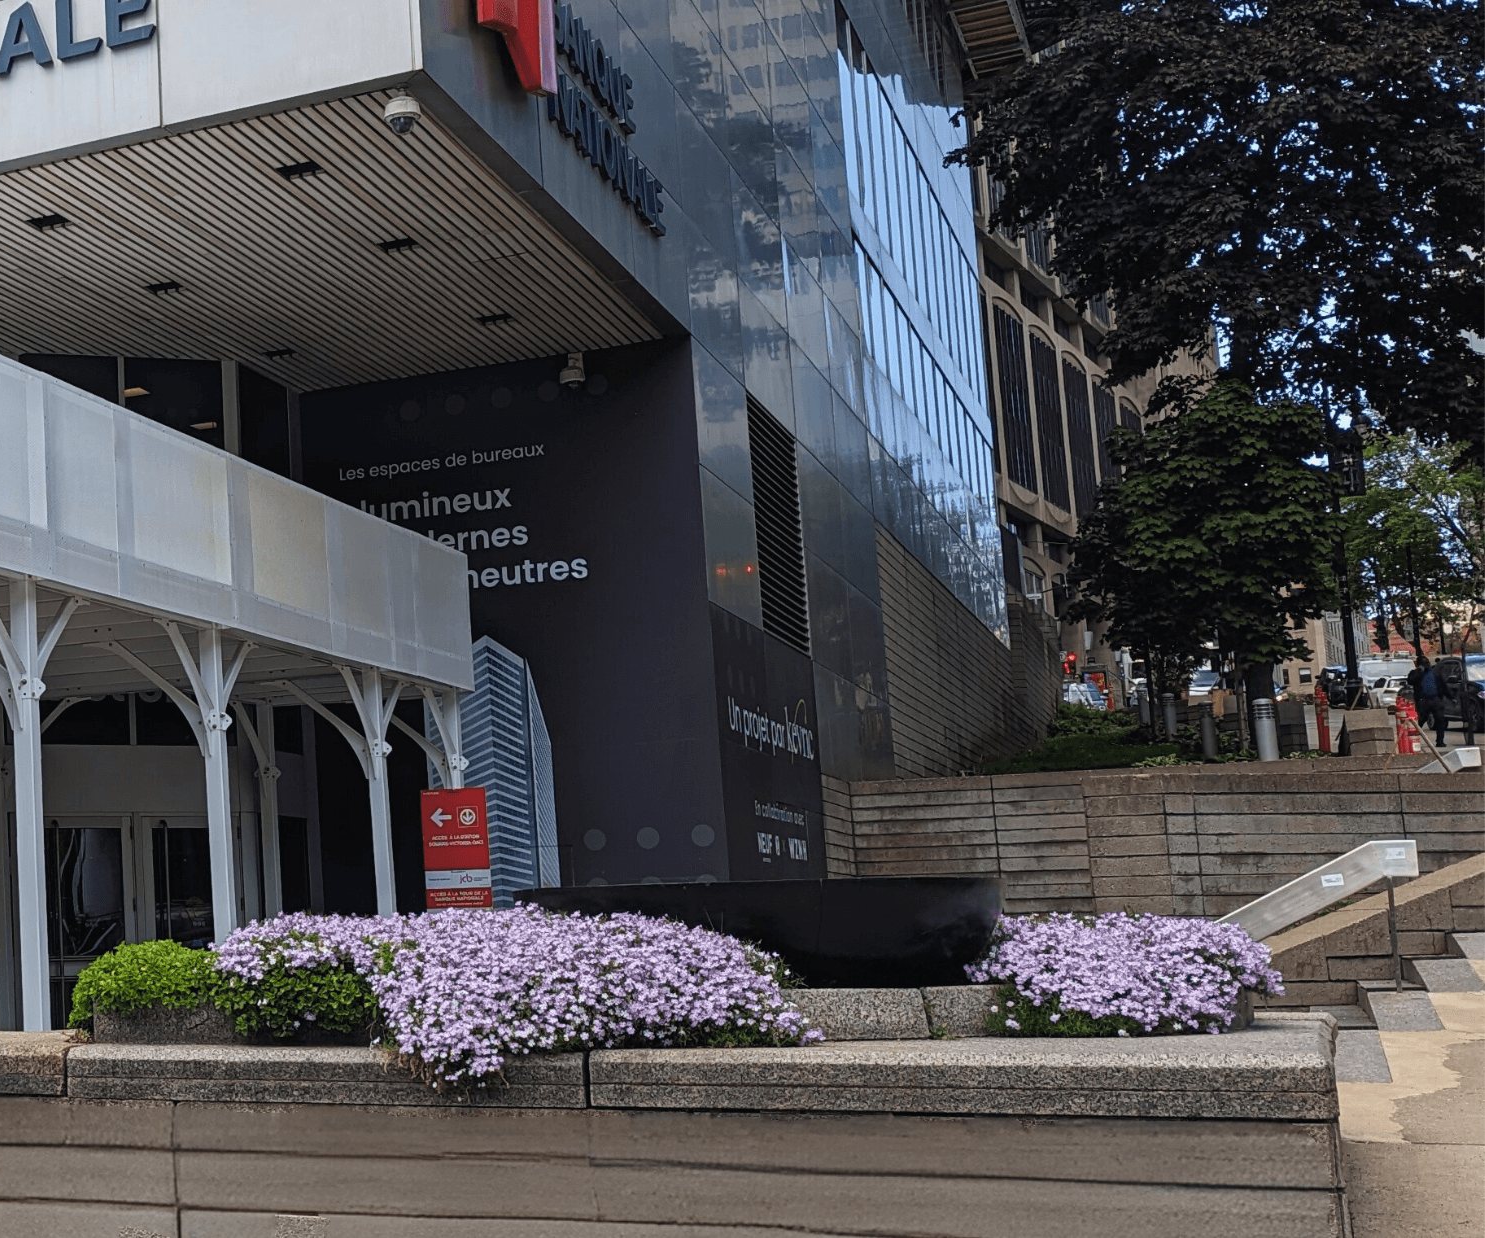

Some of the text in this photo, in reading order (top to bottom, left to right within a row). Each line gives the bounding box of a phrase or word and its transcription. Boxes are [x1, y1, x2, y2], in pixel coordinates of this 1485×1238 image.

[548, 73, 666, 237] NATIONALE
[339, 443, 545, 481] Les espaces de bureaux
[727, 695, 743, 733] Un
[743, 706, 770, 751] projet
[770, 720, 786, 756] par
